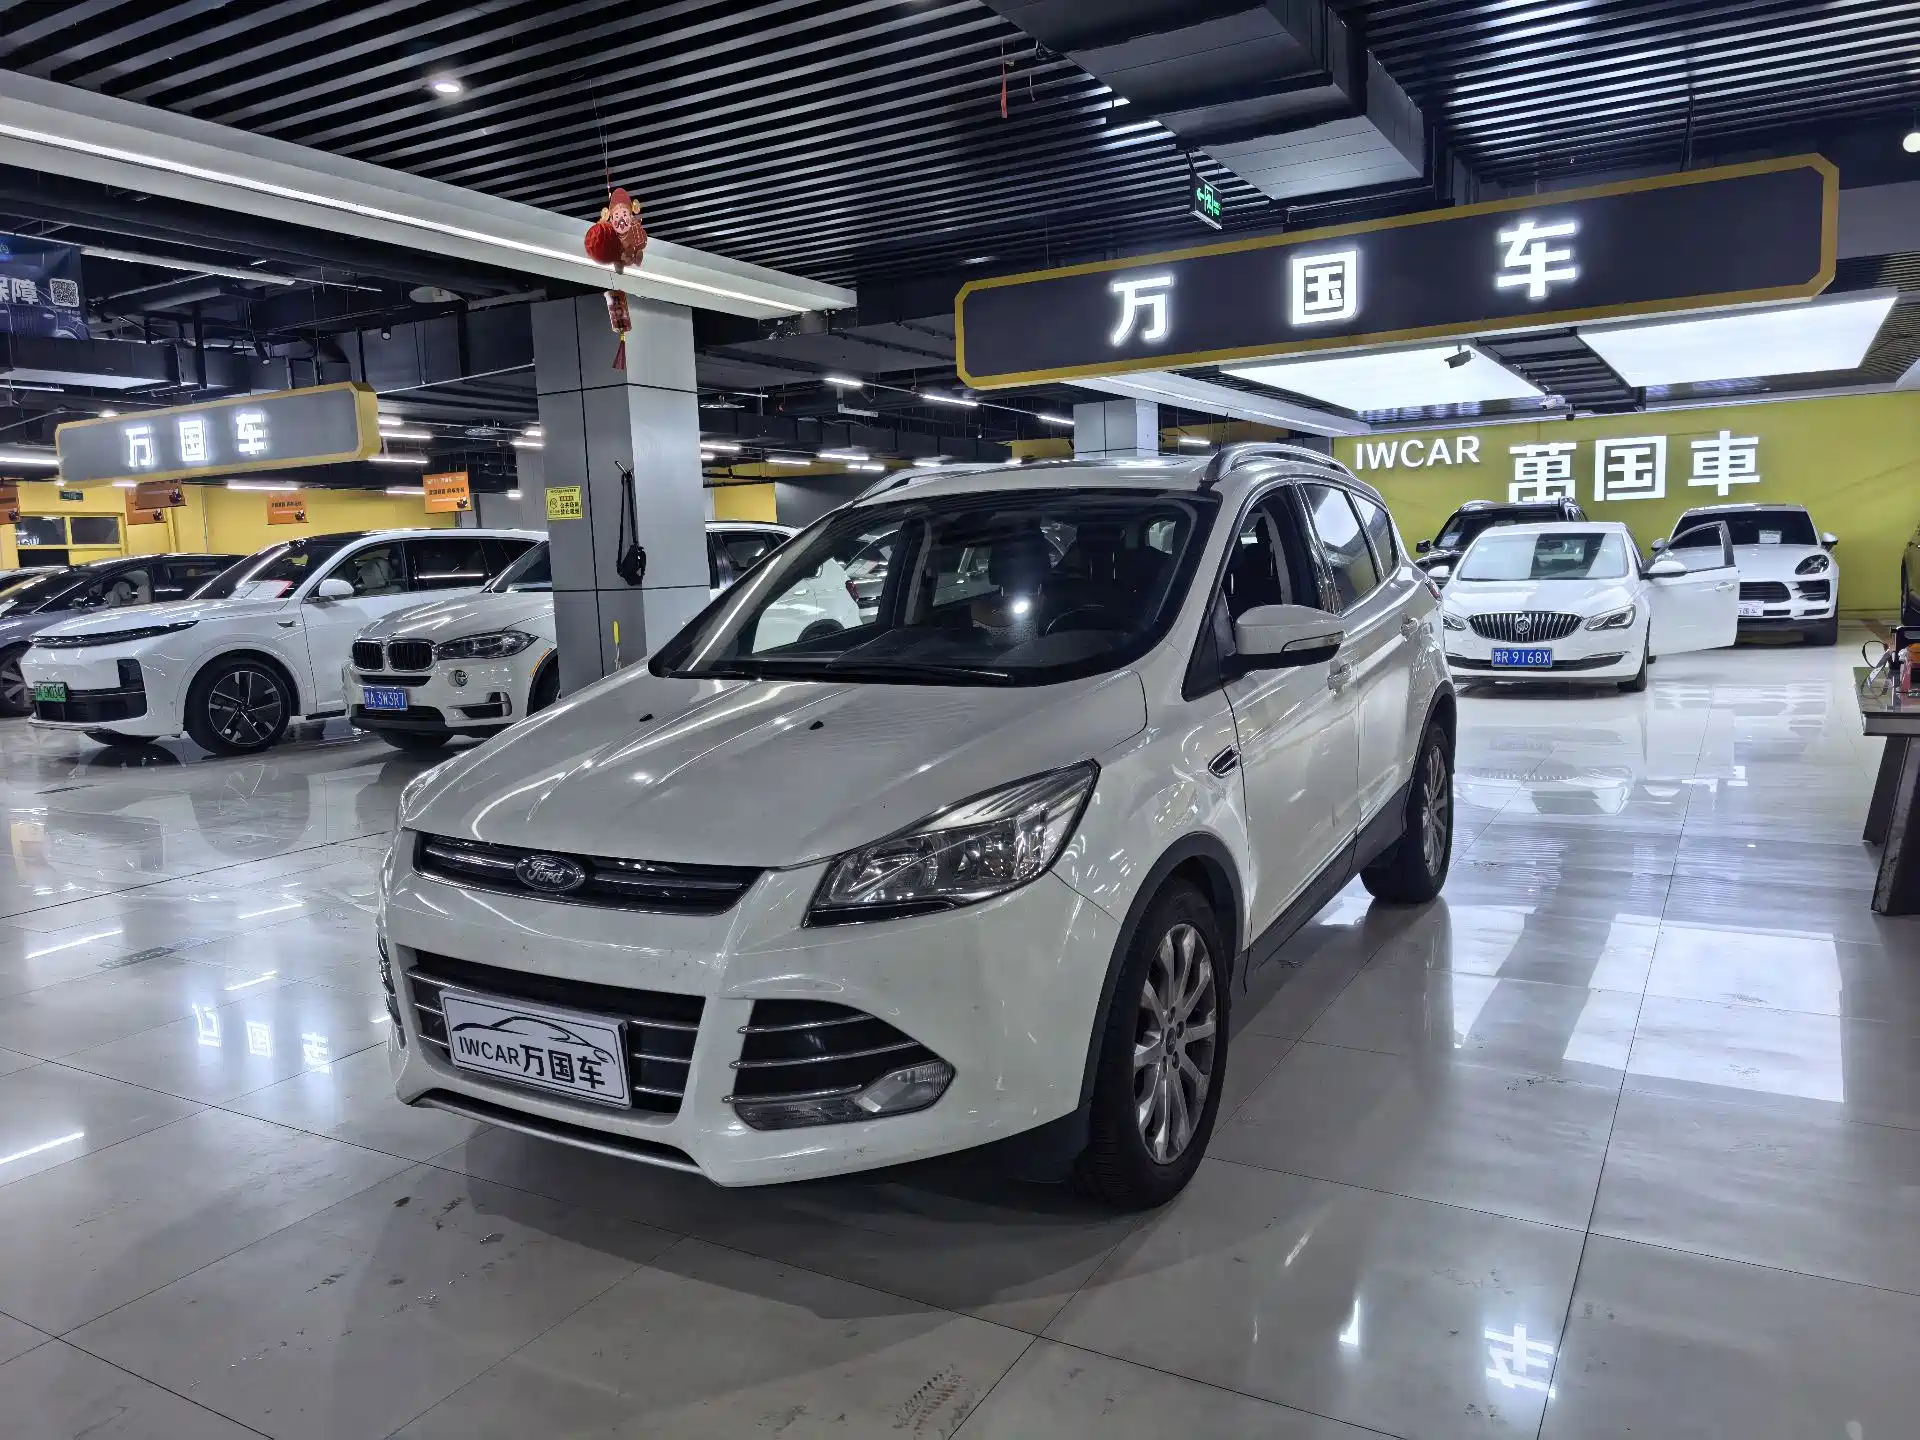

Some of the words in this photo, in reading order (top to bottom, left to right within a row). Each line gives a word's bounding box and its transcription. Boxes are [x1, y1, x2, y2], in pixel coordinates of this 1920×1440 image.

[1111, 221, 1577, 346] 万国车
[125, 413, 267, 468] 万国车
[1356, 435, 1480, 470] IWCAR
[526, 860, 566, 883] Ford
